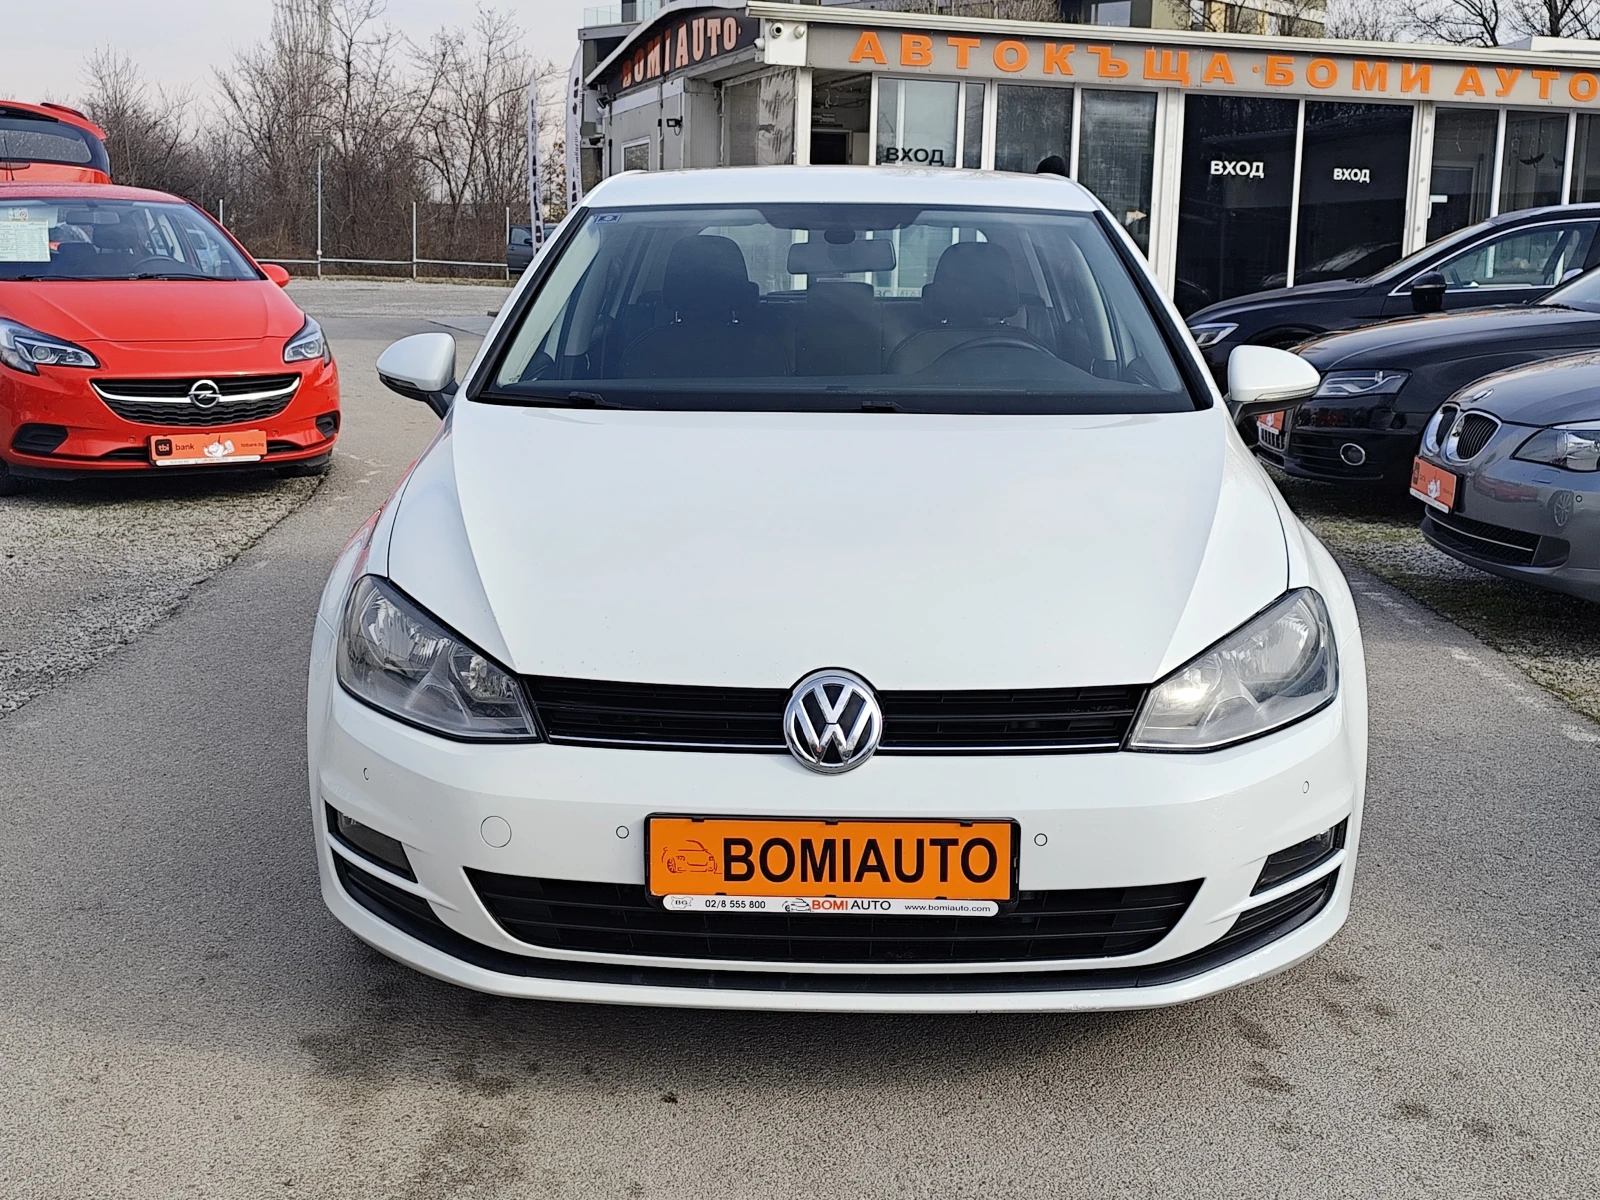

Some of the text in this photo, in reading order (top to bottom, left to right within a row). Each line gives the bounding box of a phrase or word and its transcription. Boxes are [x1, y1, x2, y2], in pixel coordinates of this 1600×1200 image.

[621, 16, 737, 88] BOMIAUTO
[849, 31, 1599, 102] АВТОКЪЩА БОМИ АУТО
[886, 147, 944, 166] ВХОД
[1210, 160, 1265, 179] ВХОД
[1333, 167, 1371, 184] ВХОД
[157, 443, 195, 452] tbi bank
[788, 677, 878, 769] VW
[723, 837, 998, 883] BOMIAUTO
[705, 899, 766, 909] 02/8 555 800
[811, 899, 892, 911] BOMI AUTO
[904, 903, 991, 913] www.bomiauto.com
